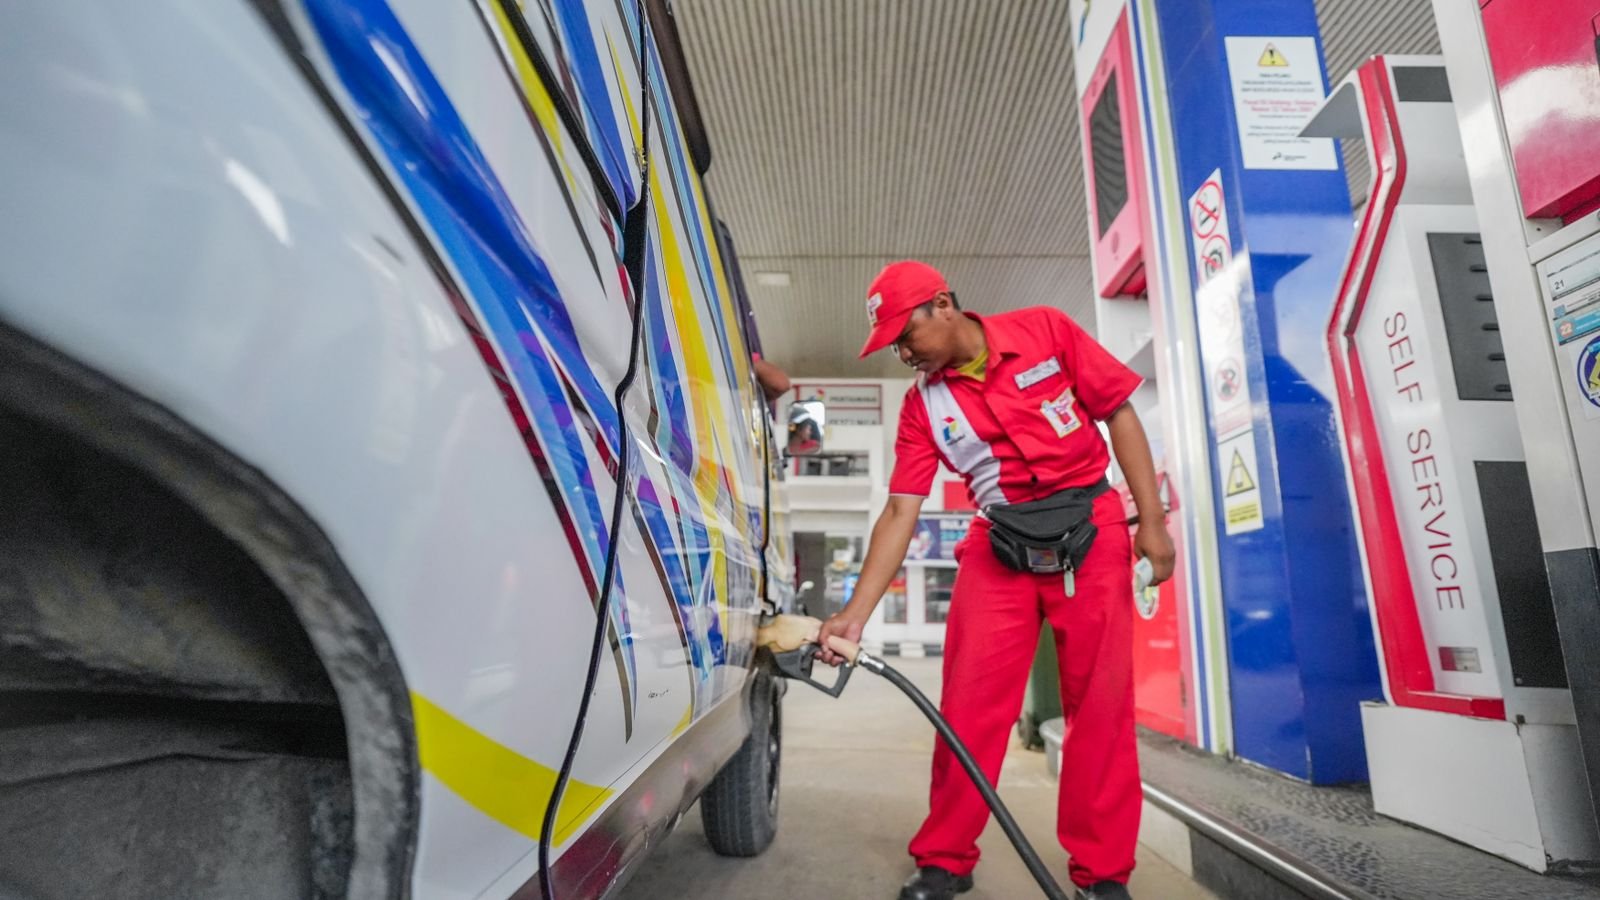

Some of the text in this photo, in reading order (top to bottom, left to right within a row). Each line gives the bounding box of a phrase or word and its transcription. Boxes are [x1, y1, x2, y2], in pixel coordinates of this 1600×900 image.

[1554, 279, 1565, 290] 21
[1384, 311, 1465, 611] SELF SERVICE
